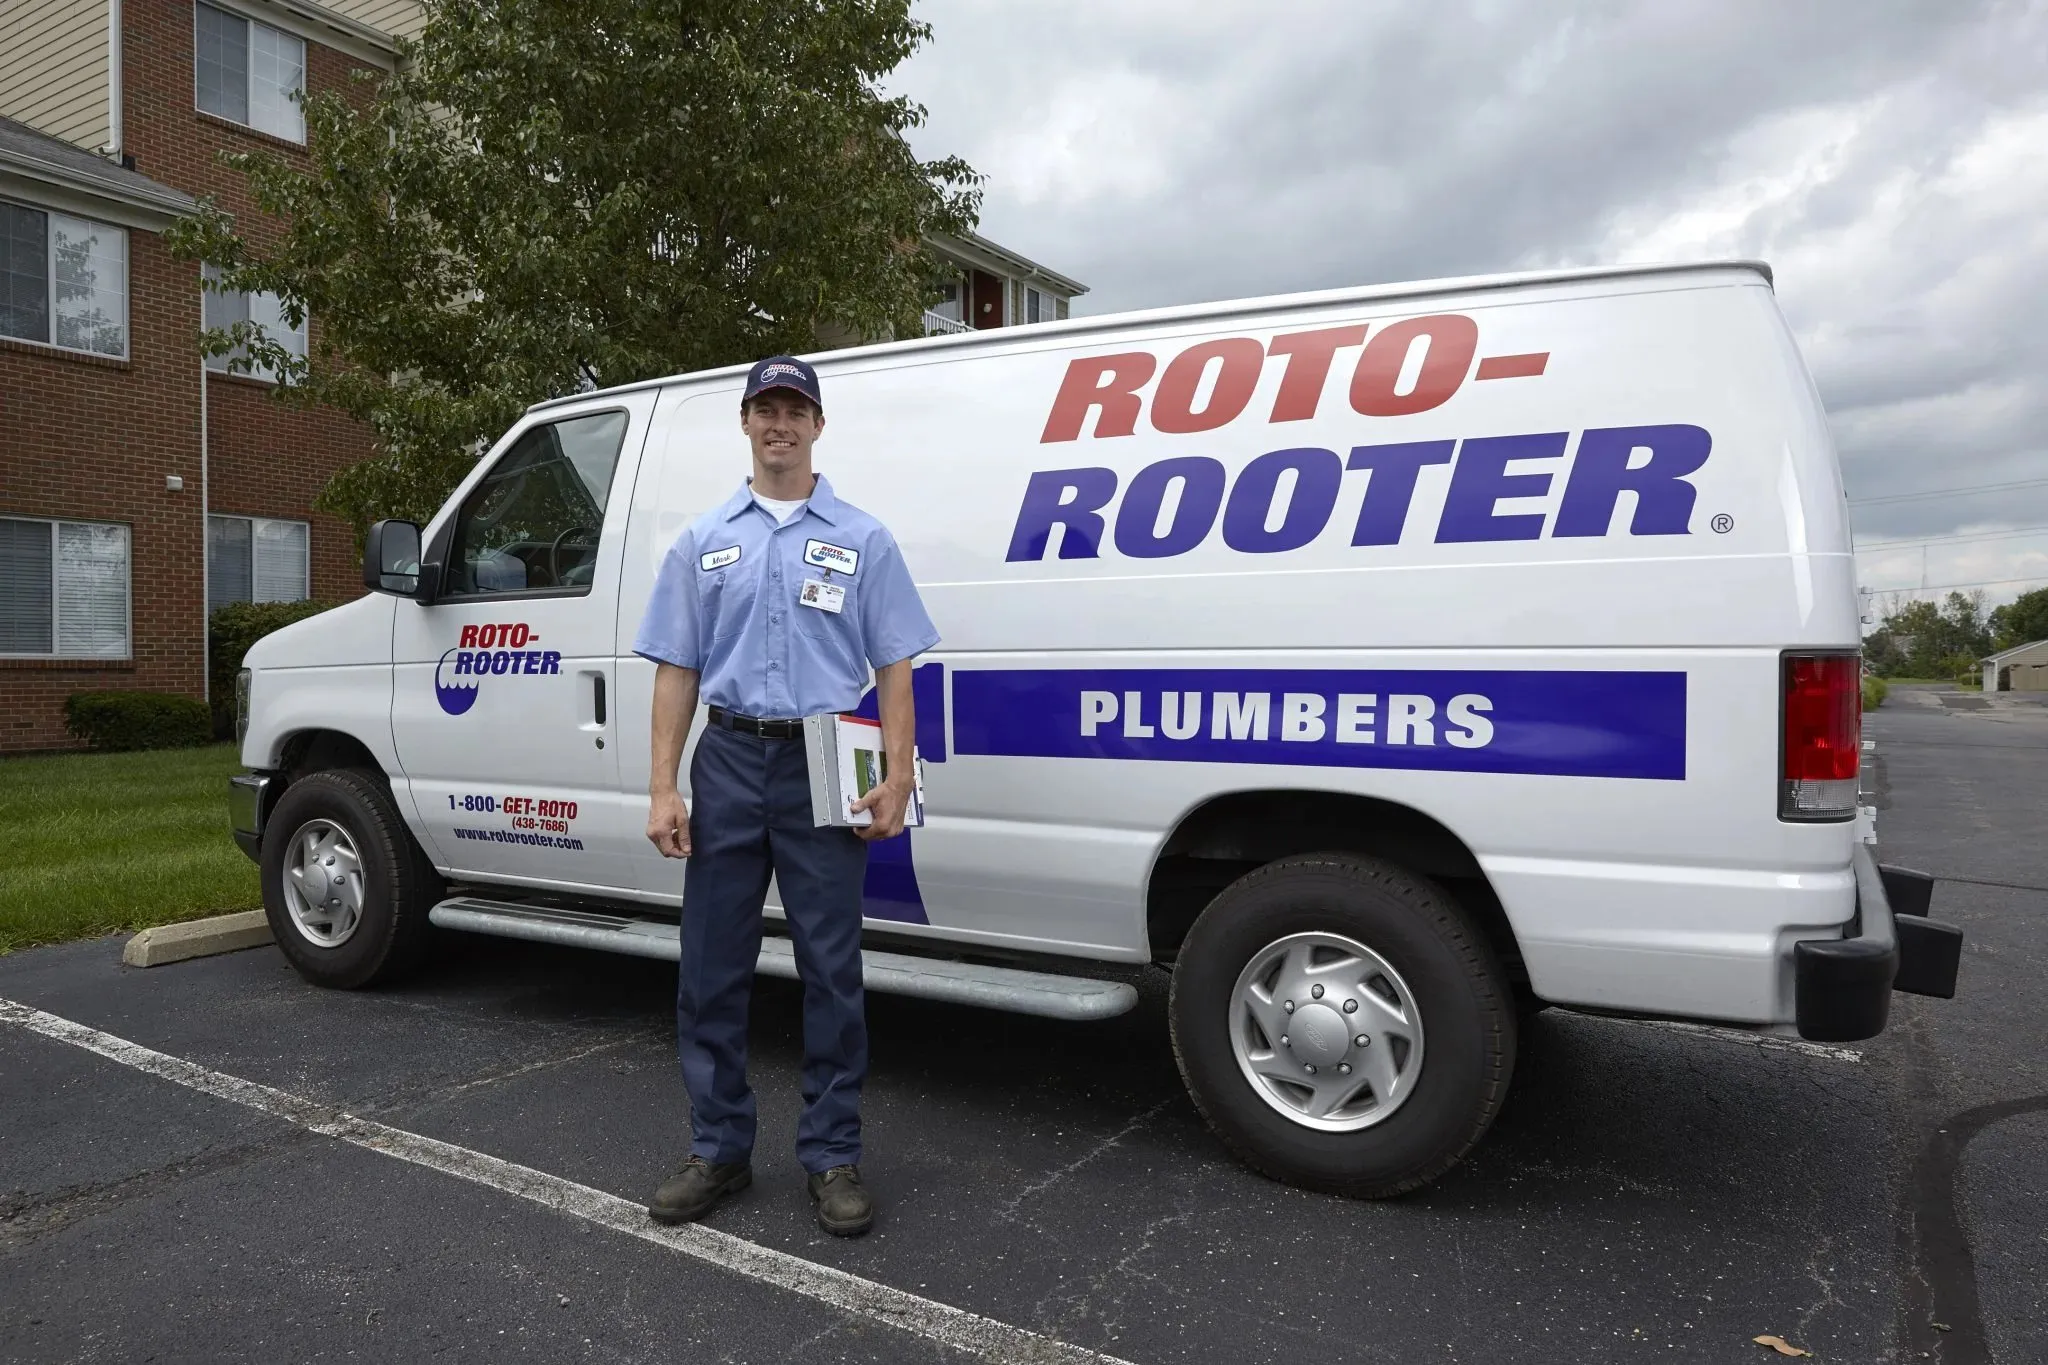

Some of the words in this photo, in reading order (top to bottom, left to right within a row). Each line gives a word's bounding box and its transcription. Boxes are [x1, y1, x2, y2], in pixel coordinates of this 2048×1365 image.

[1039, 314, 1550, 444] ROTO-
[1004, 424, 1713, 563] ROOTER
[459, 623, 540, 649] ROTO-
[454, 650, 562, 675] ROOTER
[1079, 690, 1495, 749] PLUMBERS
[511, 816, 569, 835] (438-7686)
[453, 828, 584, 851] www.rotorooter.com
